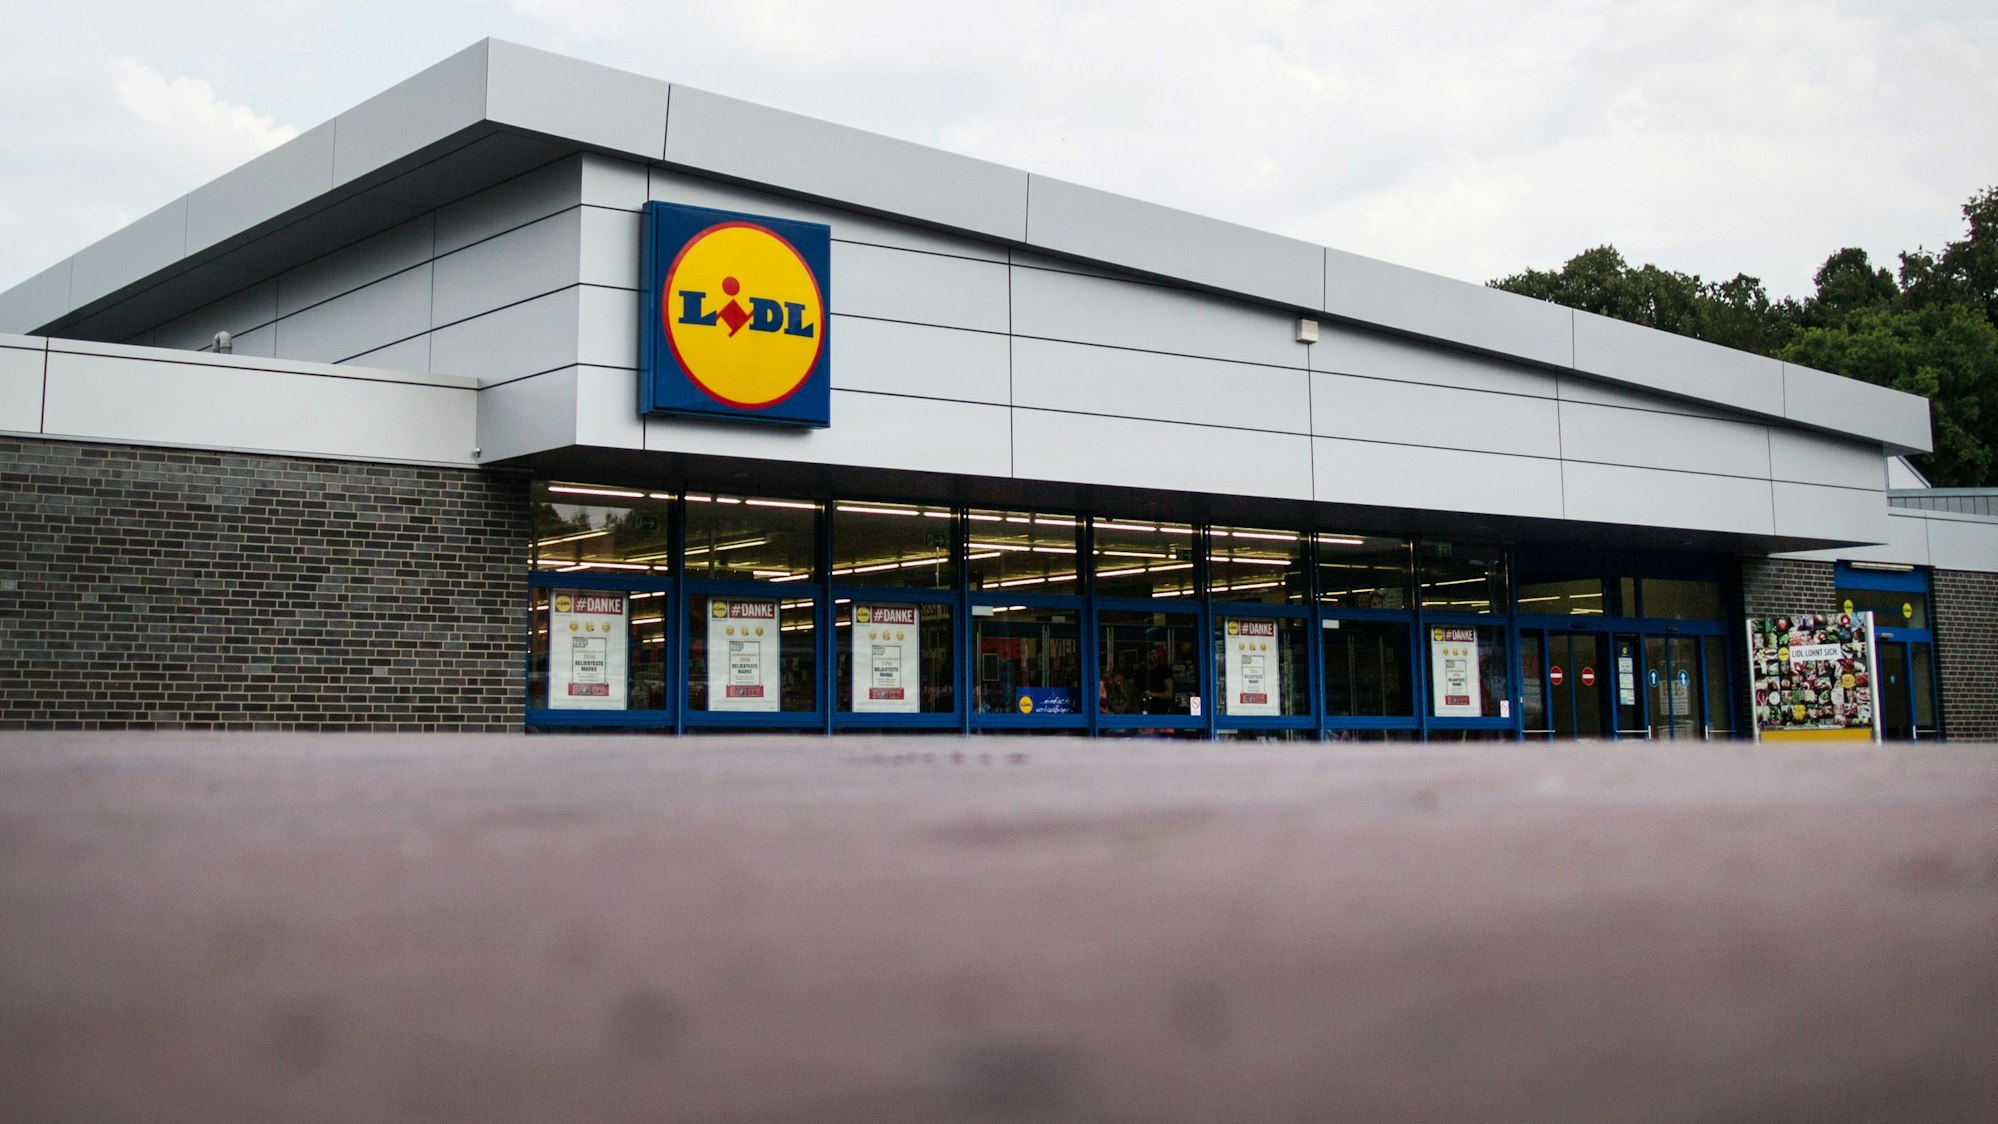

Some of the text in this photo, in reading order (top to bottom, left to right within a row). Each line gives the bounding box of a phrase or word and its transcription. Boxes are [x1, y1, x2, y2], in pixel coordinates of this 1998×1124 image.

[575, 597, 622, 613] #DANKE
[731, 603, 774, 617] #DANKE
[873, 608, 913, 623] #DANKE
[1241, 622, 1273, 635] #DANKE
[1445, 628, 1473, 641] #DANKE
[1792, 650, 1805, 658] LIDL
[1805, 649, 1823, 657] LOHNT
